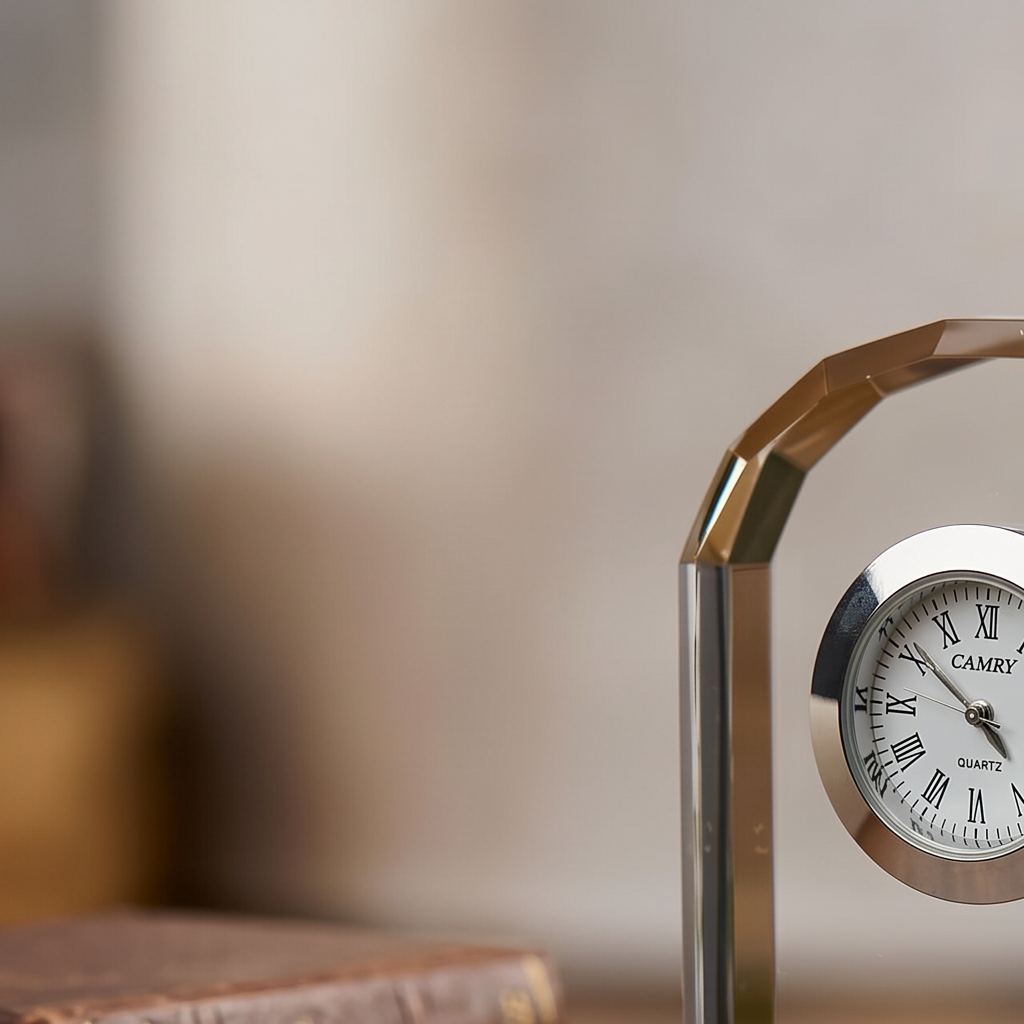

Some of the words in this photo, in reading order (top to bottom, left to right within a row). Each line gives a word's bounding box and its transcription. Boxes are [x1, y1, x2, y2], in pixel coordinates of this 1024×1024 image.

[931, 610, 961, 650] XI
[975, 603, 1000, 640] XII
[898, 644, 930, 677] X
[951, 654, 1018, 675] CAMRY
[885, 692, 917, 717] IX
[890, 731, 926, 772] VIII
[957, 757, 1003, 773] QUARTZ
[921, 768, 950, 810] VII
[967, 787, 986, 824] VI
